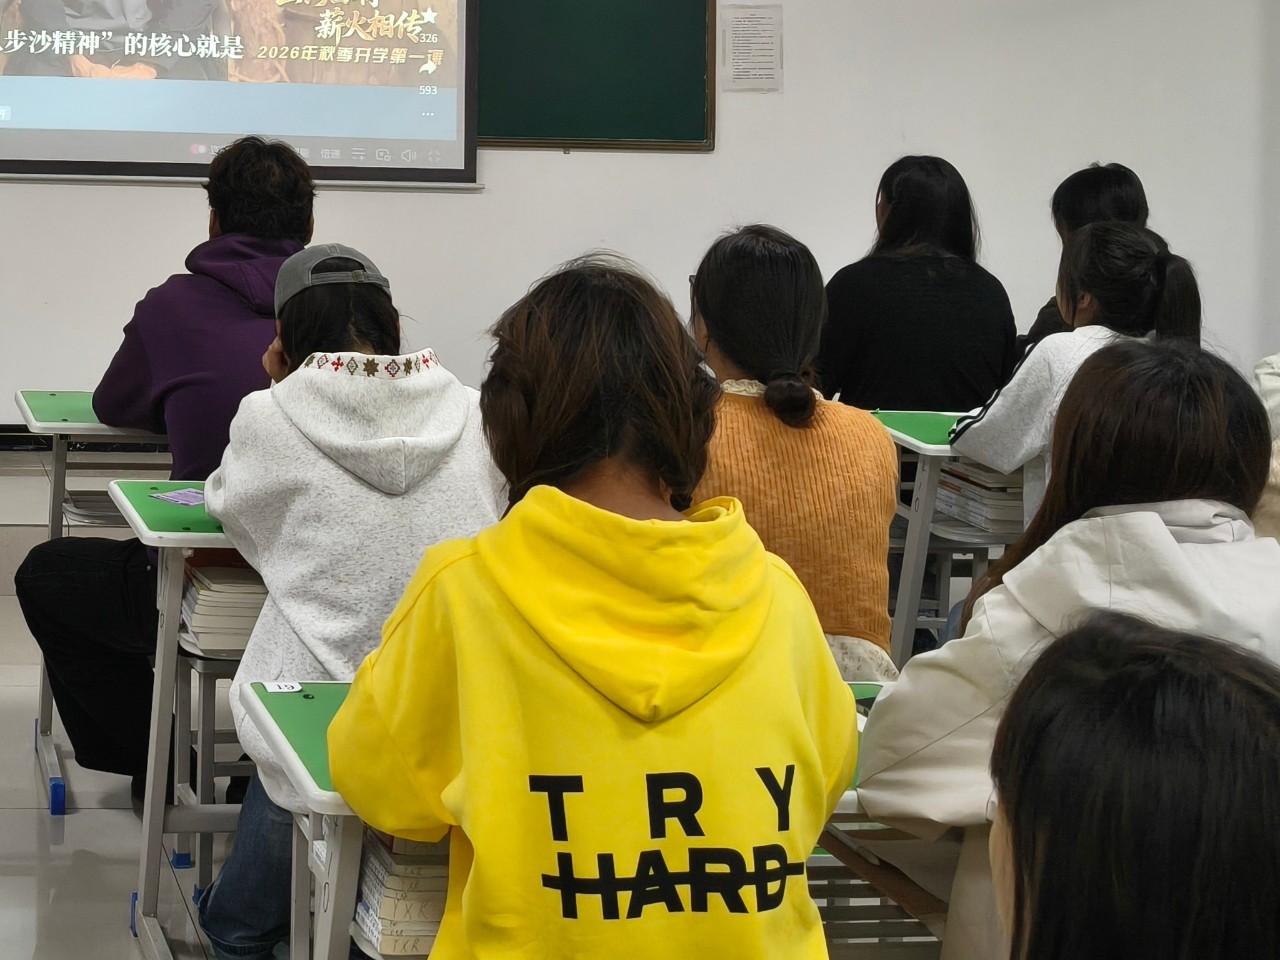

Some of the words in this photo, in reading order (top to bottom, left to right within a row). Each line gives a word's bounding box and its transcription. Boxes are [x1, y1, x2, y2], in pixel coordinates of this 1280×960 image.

[314, 7, 425, 45] 薪火相传
[419, 33, 438, 43] 326
[419, 85, 438, 95] 593
[556, 843, 788, 920] HARD
